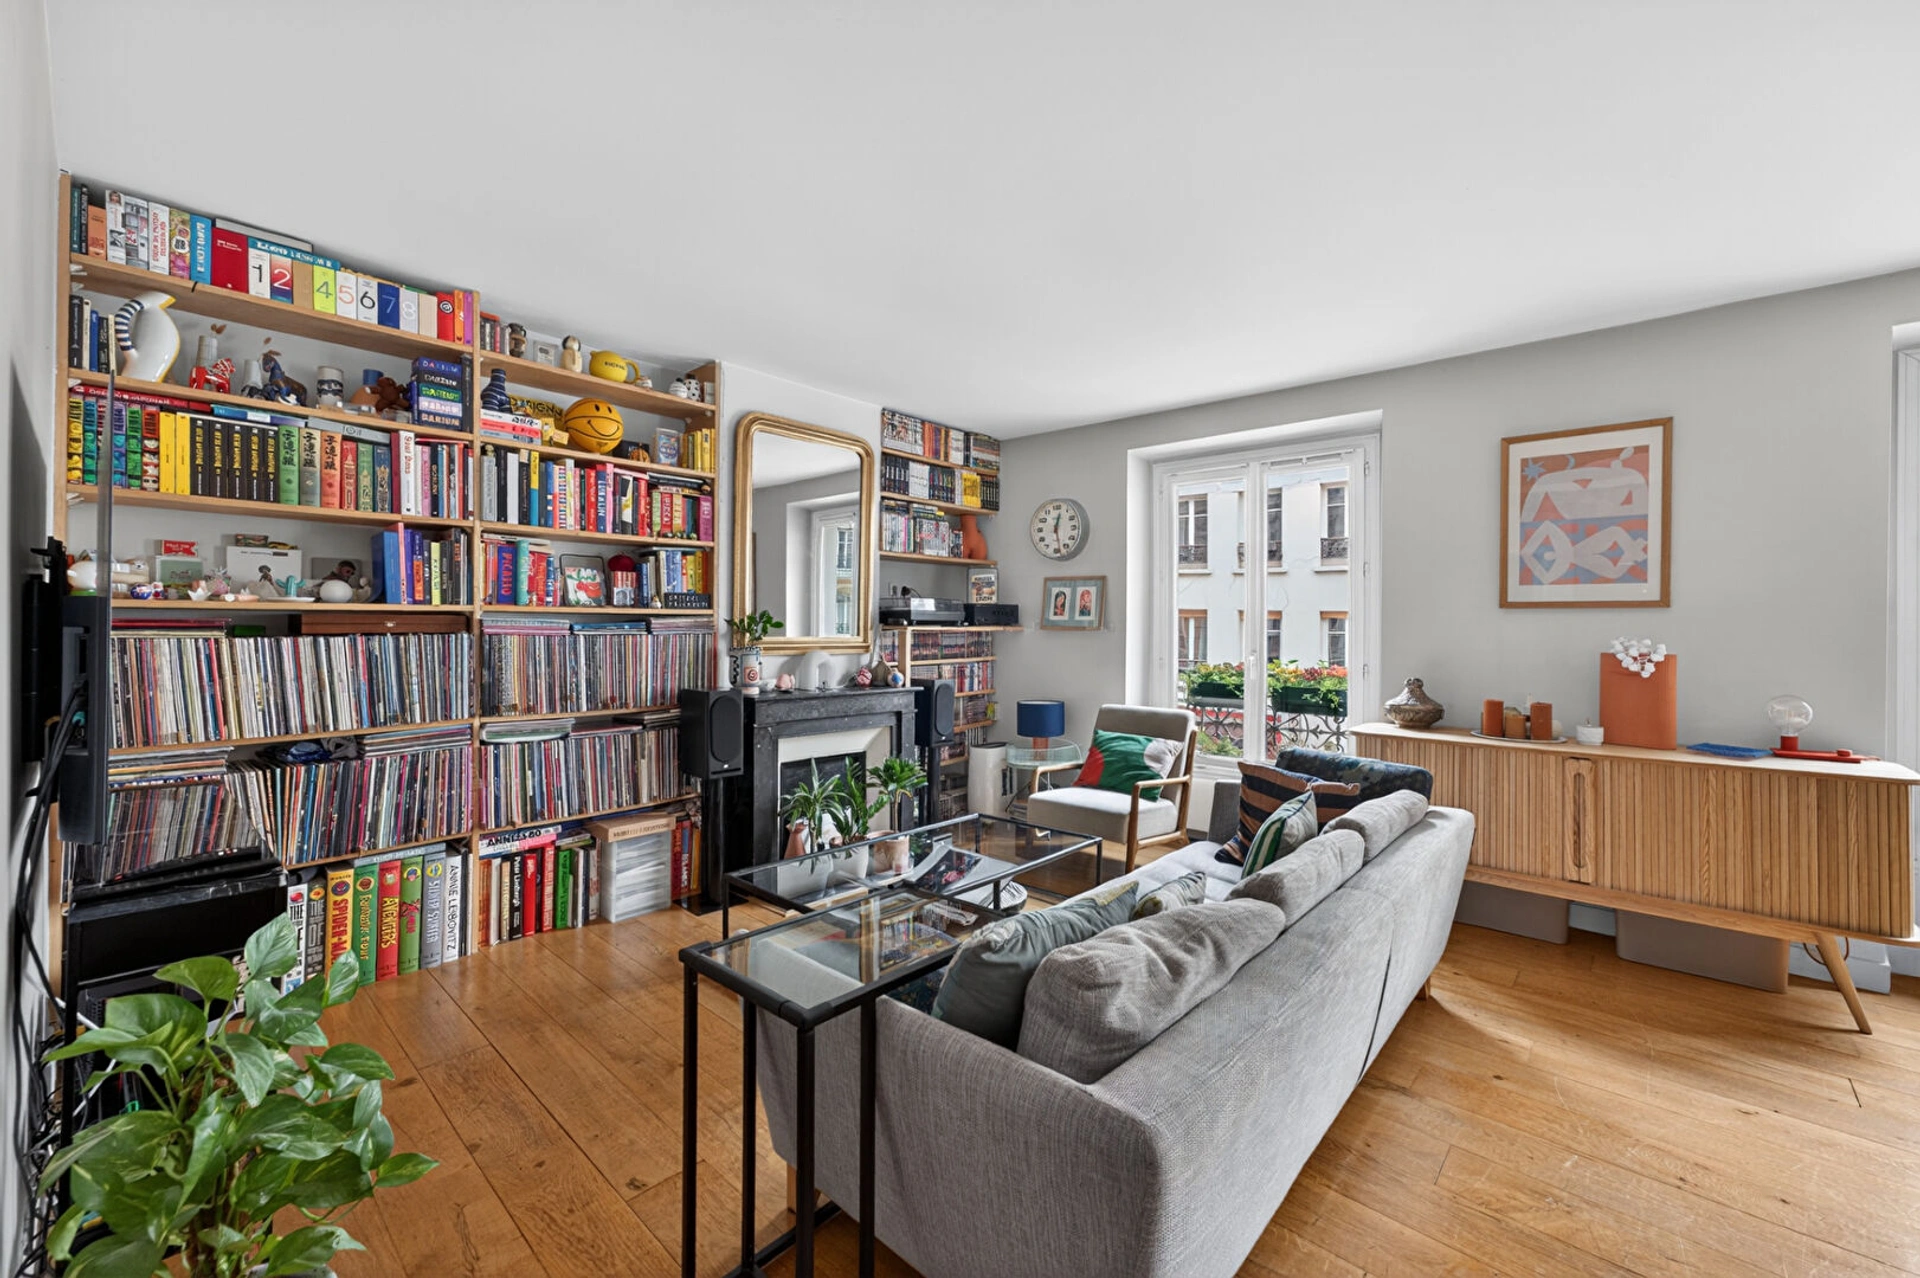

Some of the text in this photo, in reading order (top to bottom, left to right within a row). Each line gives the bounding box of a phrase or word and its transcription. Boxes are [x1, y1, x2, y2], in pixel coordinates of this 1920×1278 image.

[252, 264, 263, 283] 1
[273, 268, 292, 290] 2
[316, 281, 333, 299] 4
[339, 286, 354, 304] 5
[360, 291, 376, 310] 6
[382, 295, 396, 313] 7
[402, 301, 417, 320] 8
[448, 864, 459, 897] ANNIE
[380, 897, 399, 949] AVENGERS
